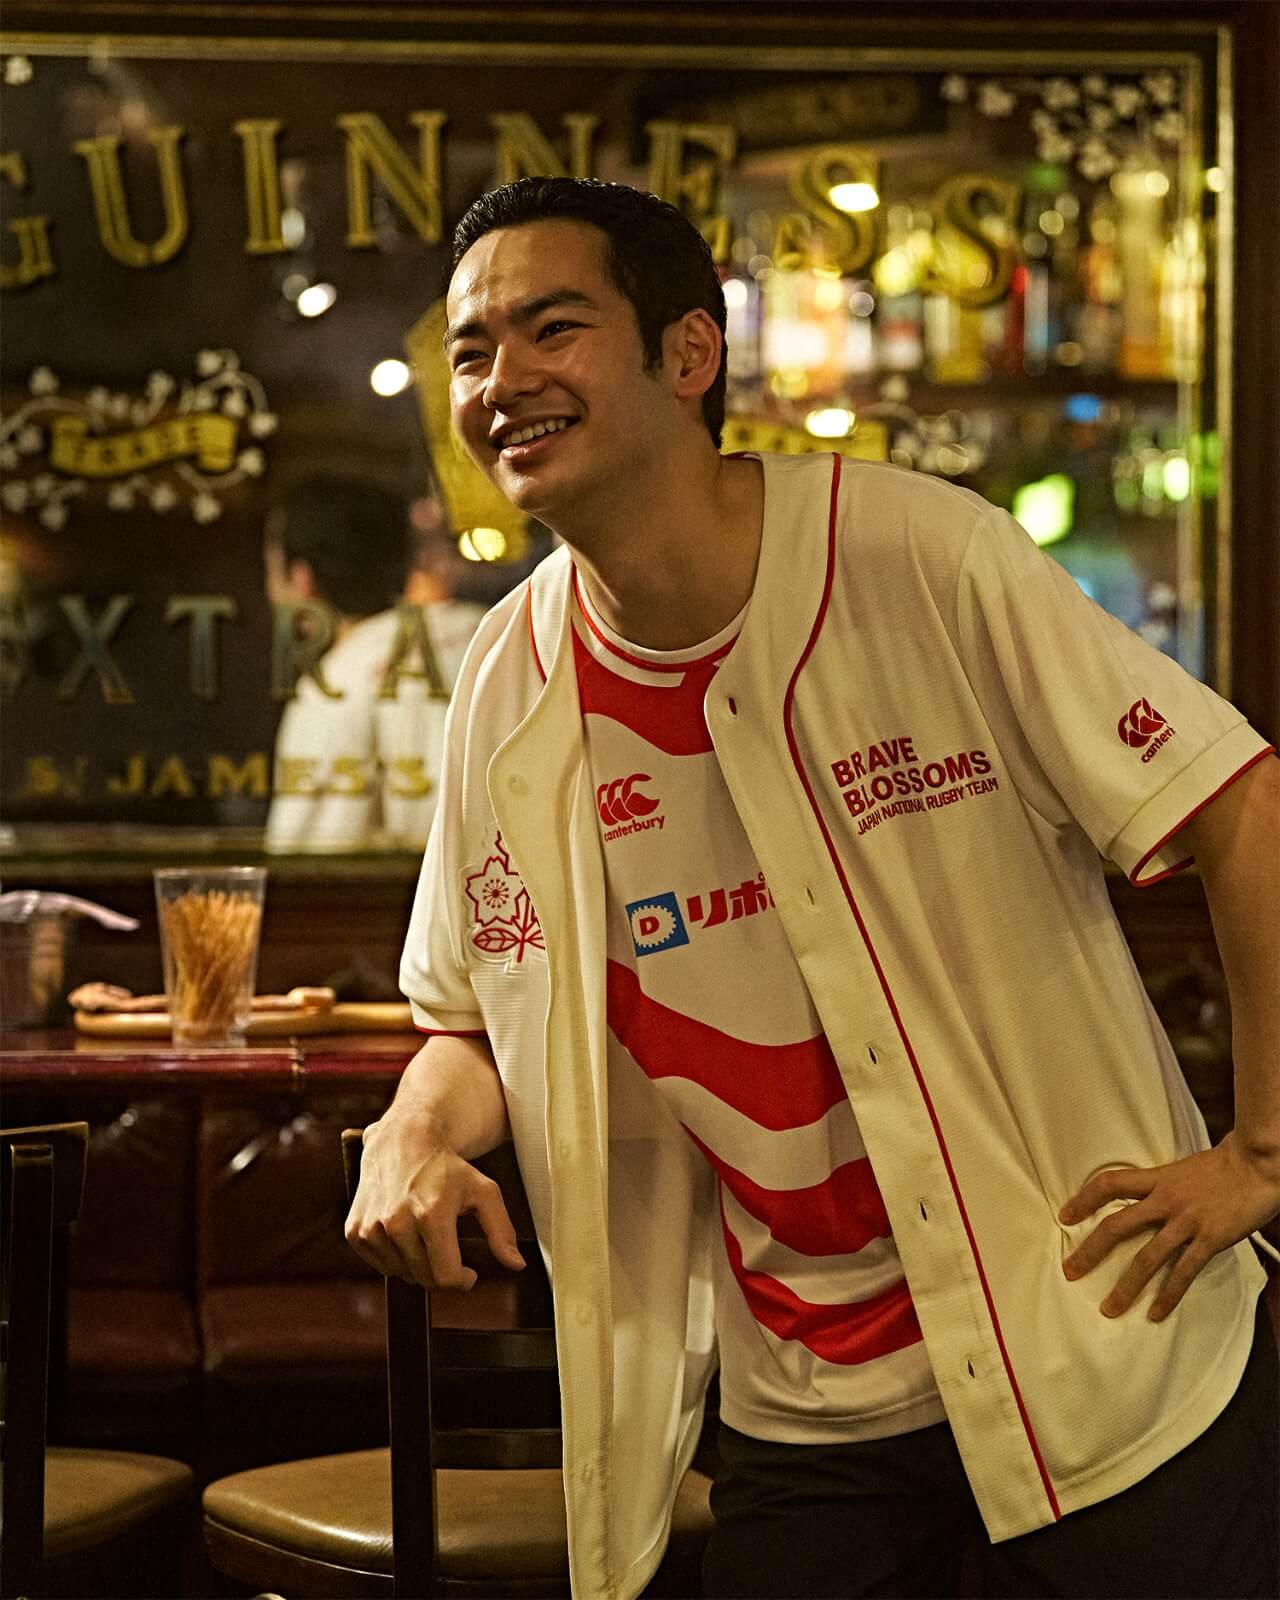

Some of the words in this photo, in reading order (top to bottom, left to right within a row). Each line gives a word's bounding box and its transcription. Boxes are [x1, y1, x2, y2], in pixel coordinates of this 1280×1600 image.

[831, 736, 919, 788] BRAVE
[843, 750, 992, 817] BLOSSOMS
[604, 815, 665, 842] canterbury
[857, 811, 882, 836] JAPAN
[880, 799, 927, 820] NATIONAL
[926, 786, 965, 810] RUGBY
[965, 777, 999, 797] TEAM
[639, 916, 660, 937] D
[686, 871, 776, 929] リポ
